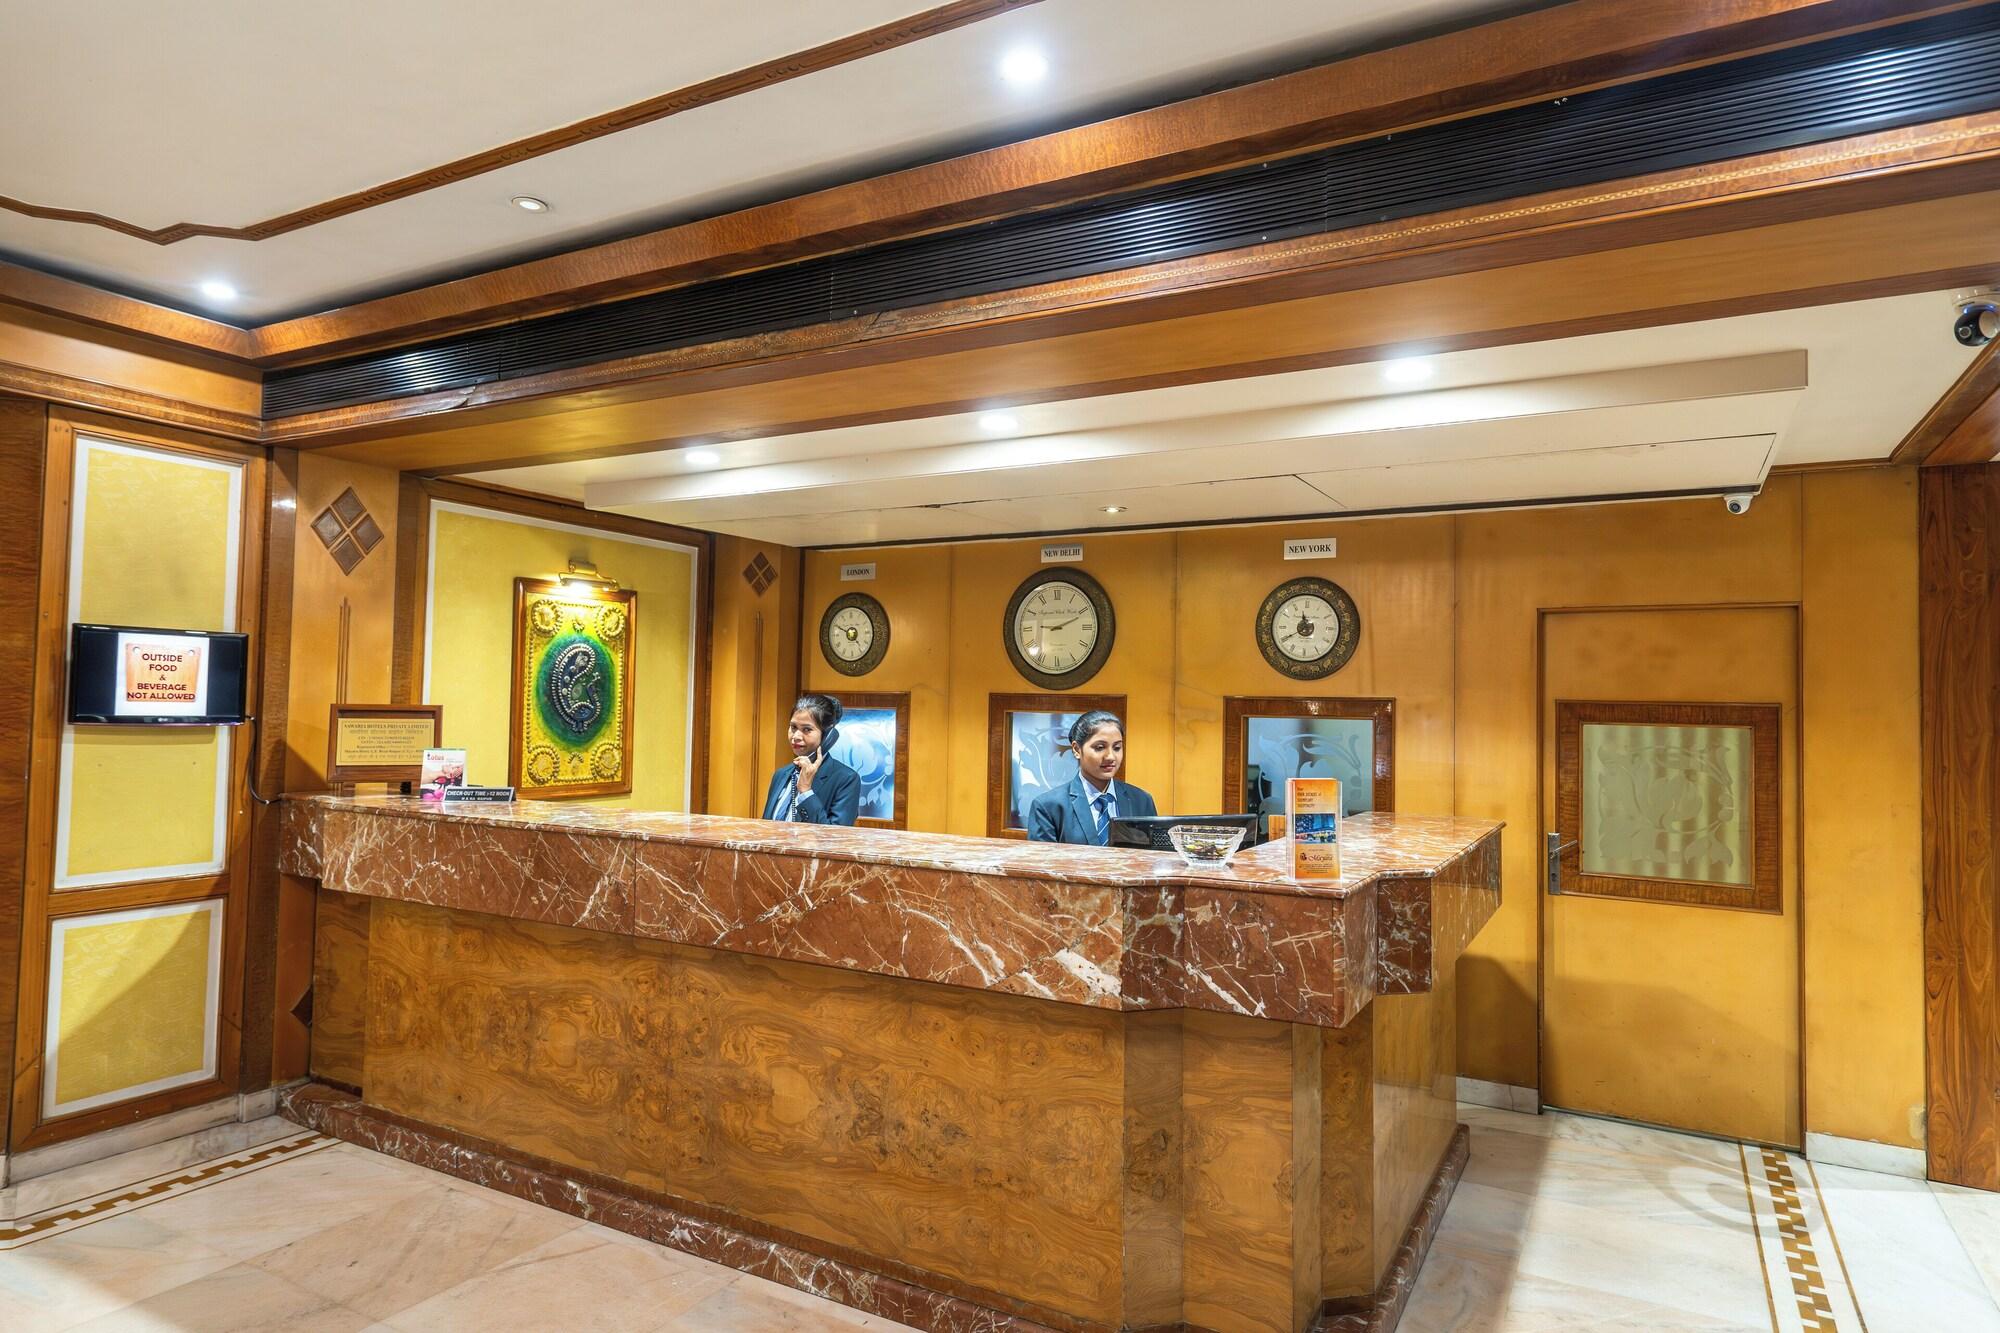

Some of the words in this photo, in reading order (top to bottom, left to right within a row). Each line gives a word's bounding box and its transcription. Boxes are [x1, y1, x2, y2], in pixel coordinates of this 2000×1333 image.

[1044, 549, 1059, 557] NEW
[1060, 548, 1080, 556] DELHI
[1288, 545, 1306, 553] NEW
[1309, 544, 1331, 552] YORK
[142, 653, 183, 662] OUTSIDE
[150, 692, 195, 700] ALLOWED
